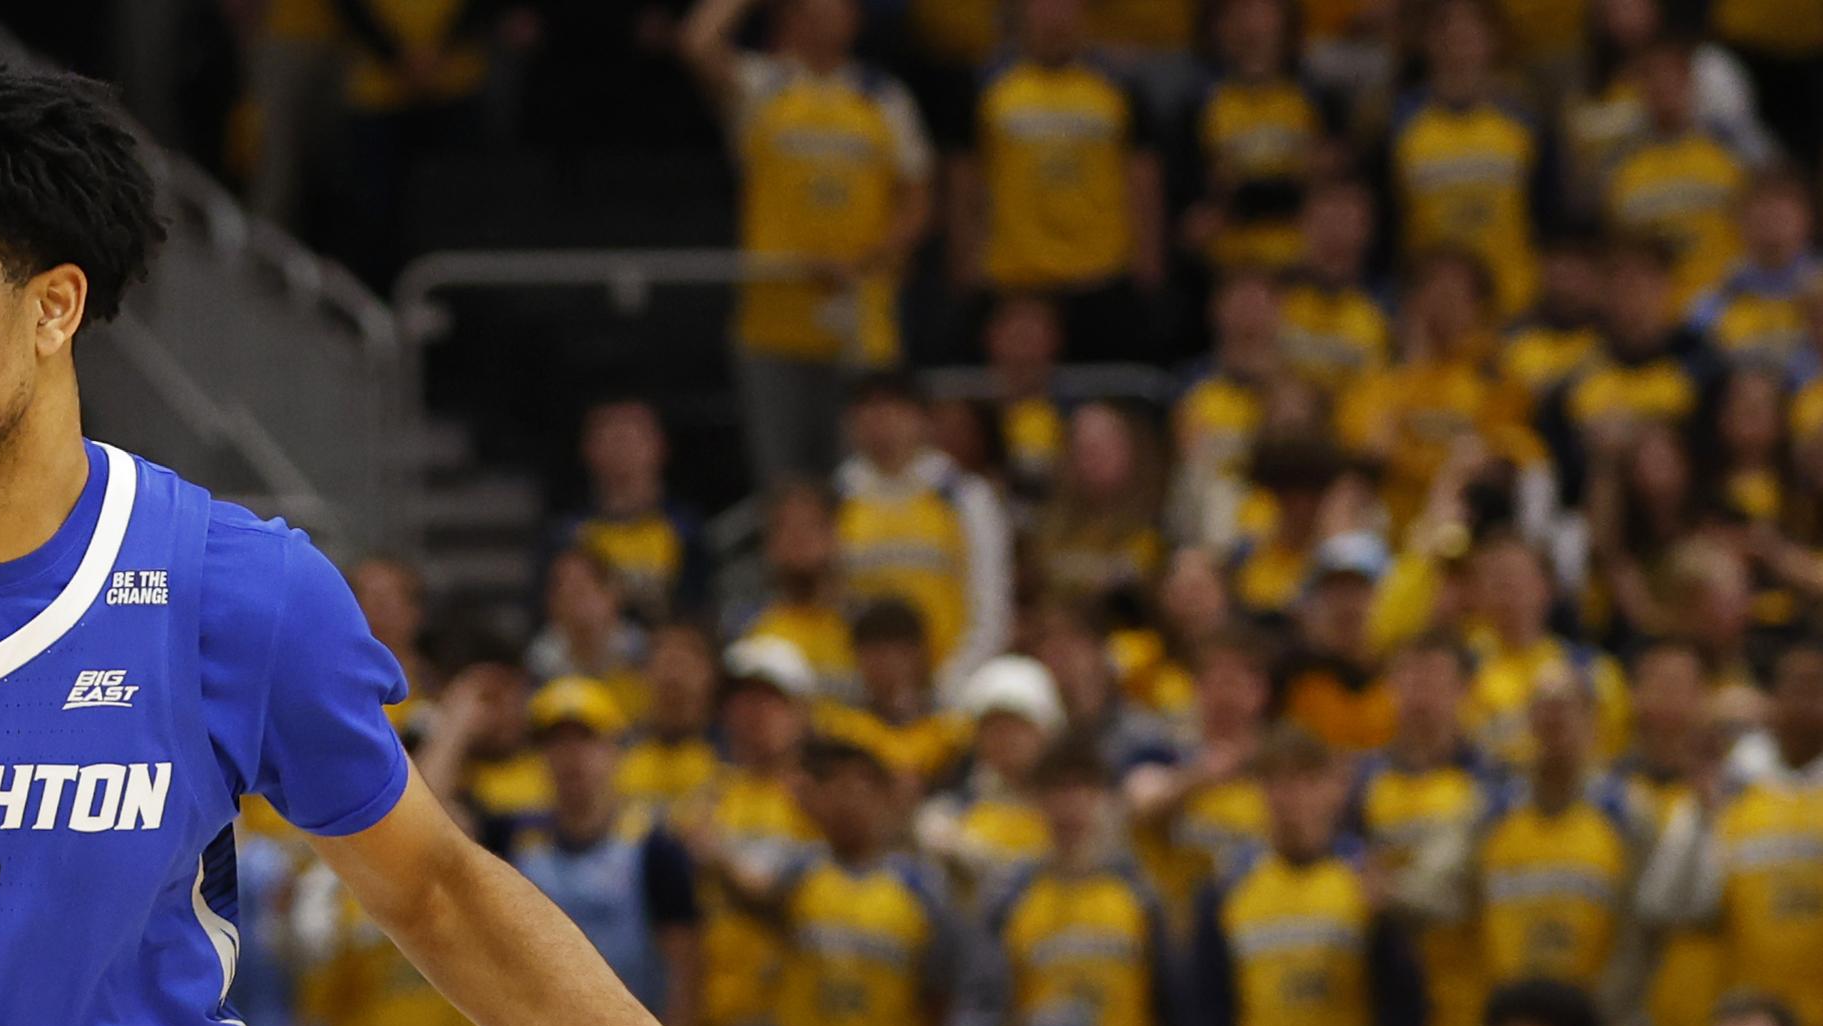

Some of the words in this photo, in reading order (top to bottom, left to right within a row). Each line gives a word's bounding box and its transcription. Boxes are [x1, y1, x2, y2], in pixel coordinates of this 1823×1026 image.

[112, 570, 135, 587] BE
[139, 570, 168, 587] THE
[106, 588, 169, 605] CHANGE
[75, 669, 127, 686] BIG
[67, 686, 139, 701] EAST
